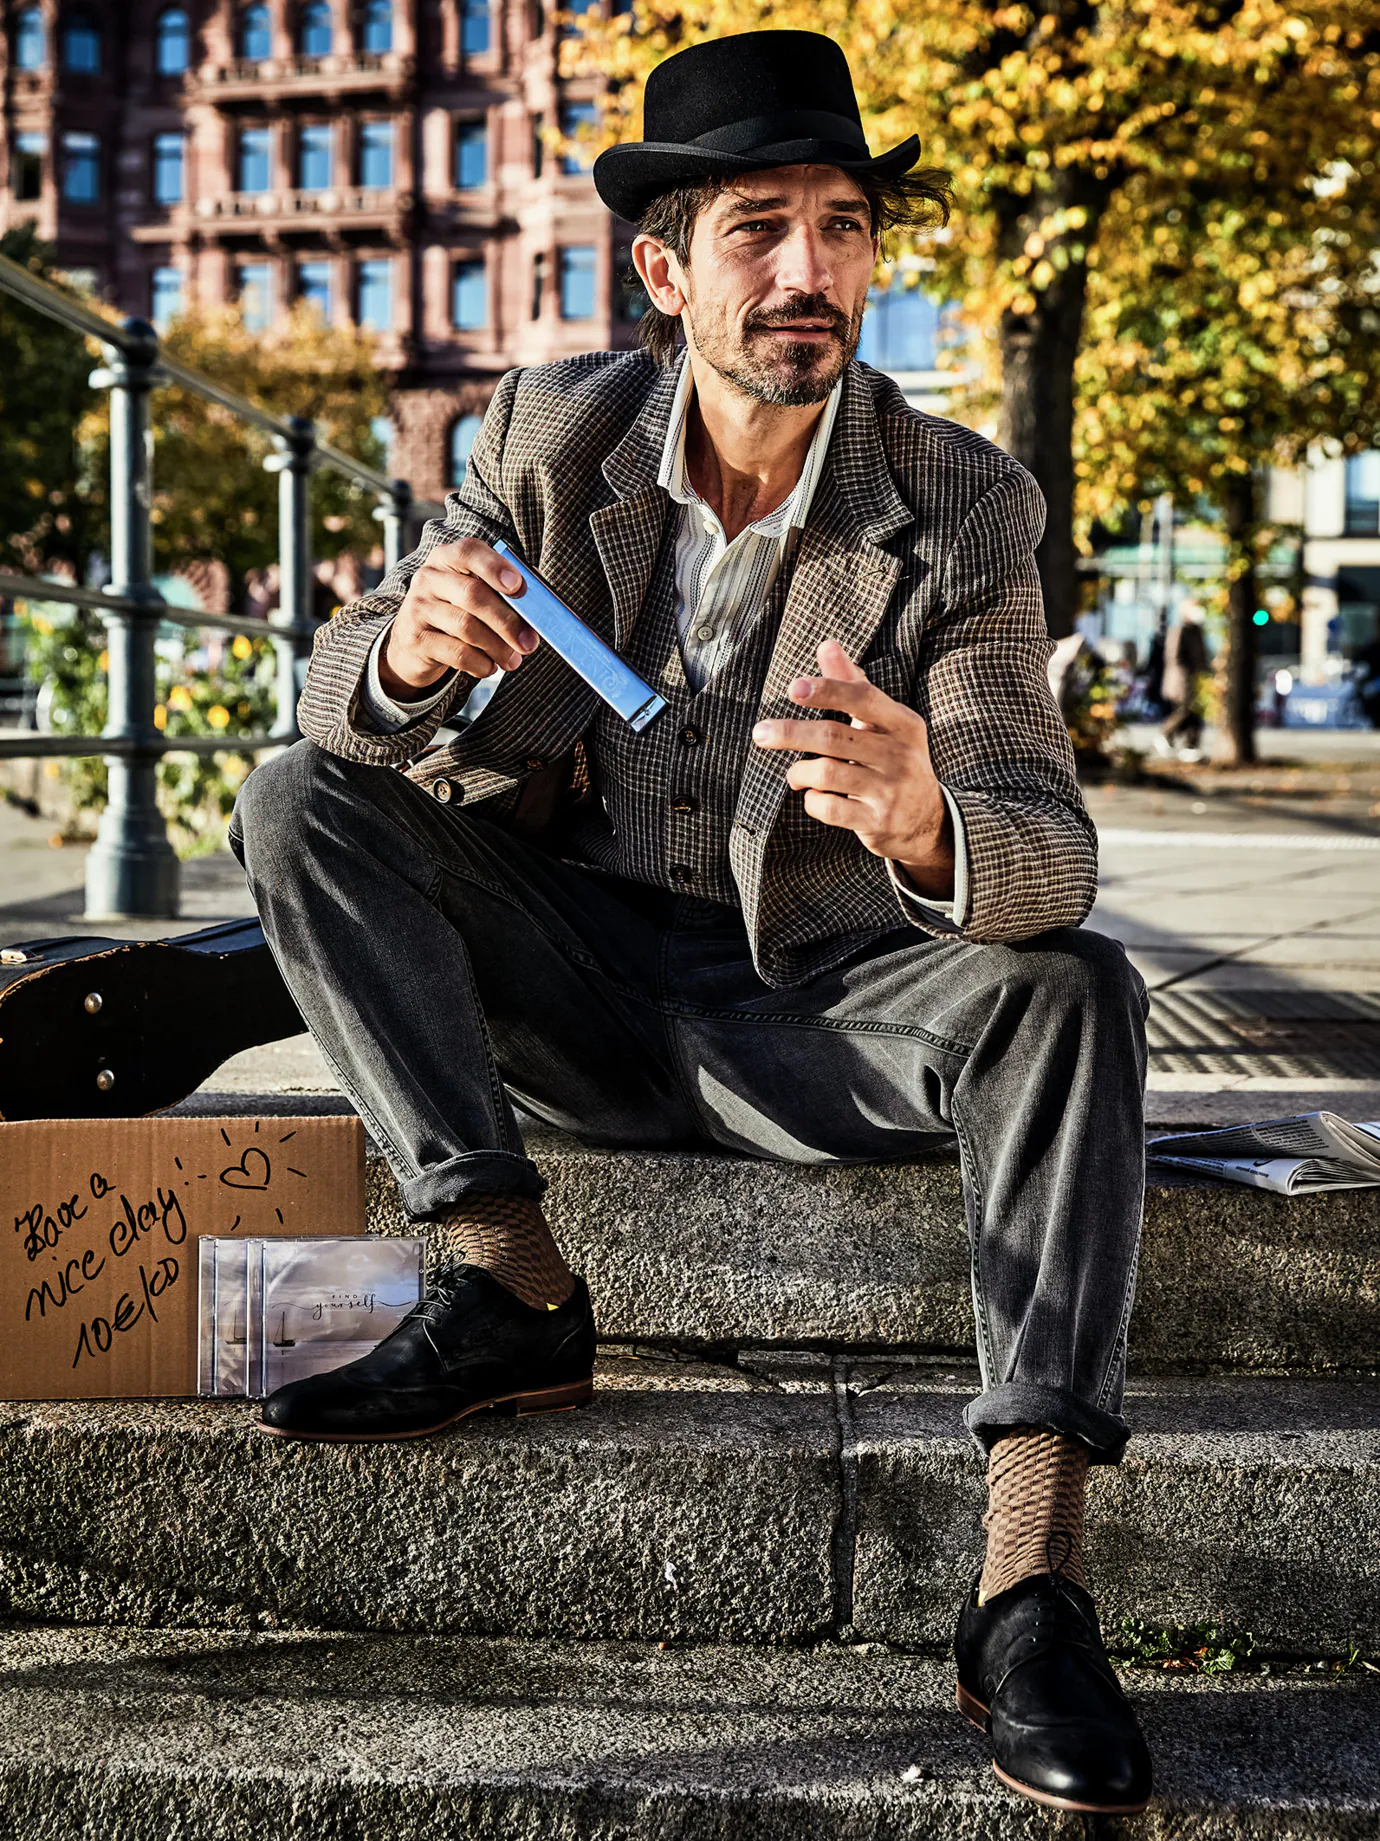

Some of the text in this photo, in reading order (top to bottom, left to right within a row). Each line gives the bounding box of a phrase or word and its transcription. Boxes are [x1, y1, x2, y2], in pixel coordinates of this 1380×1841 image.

[14, 1172, 117, 1262] Have a
[25, 1250, 106, 1321] nice
[312, 1293, 377, 1321] yourself
